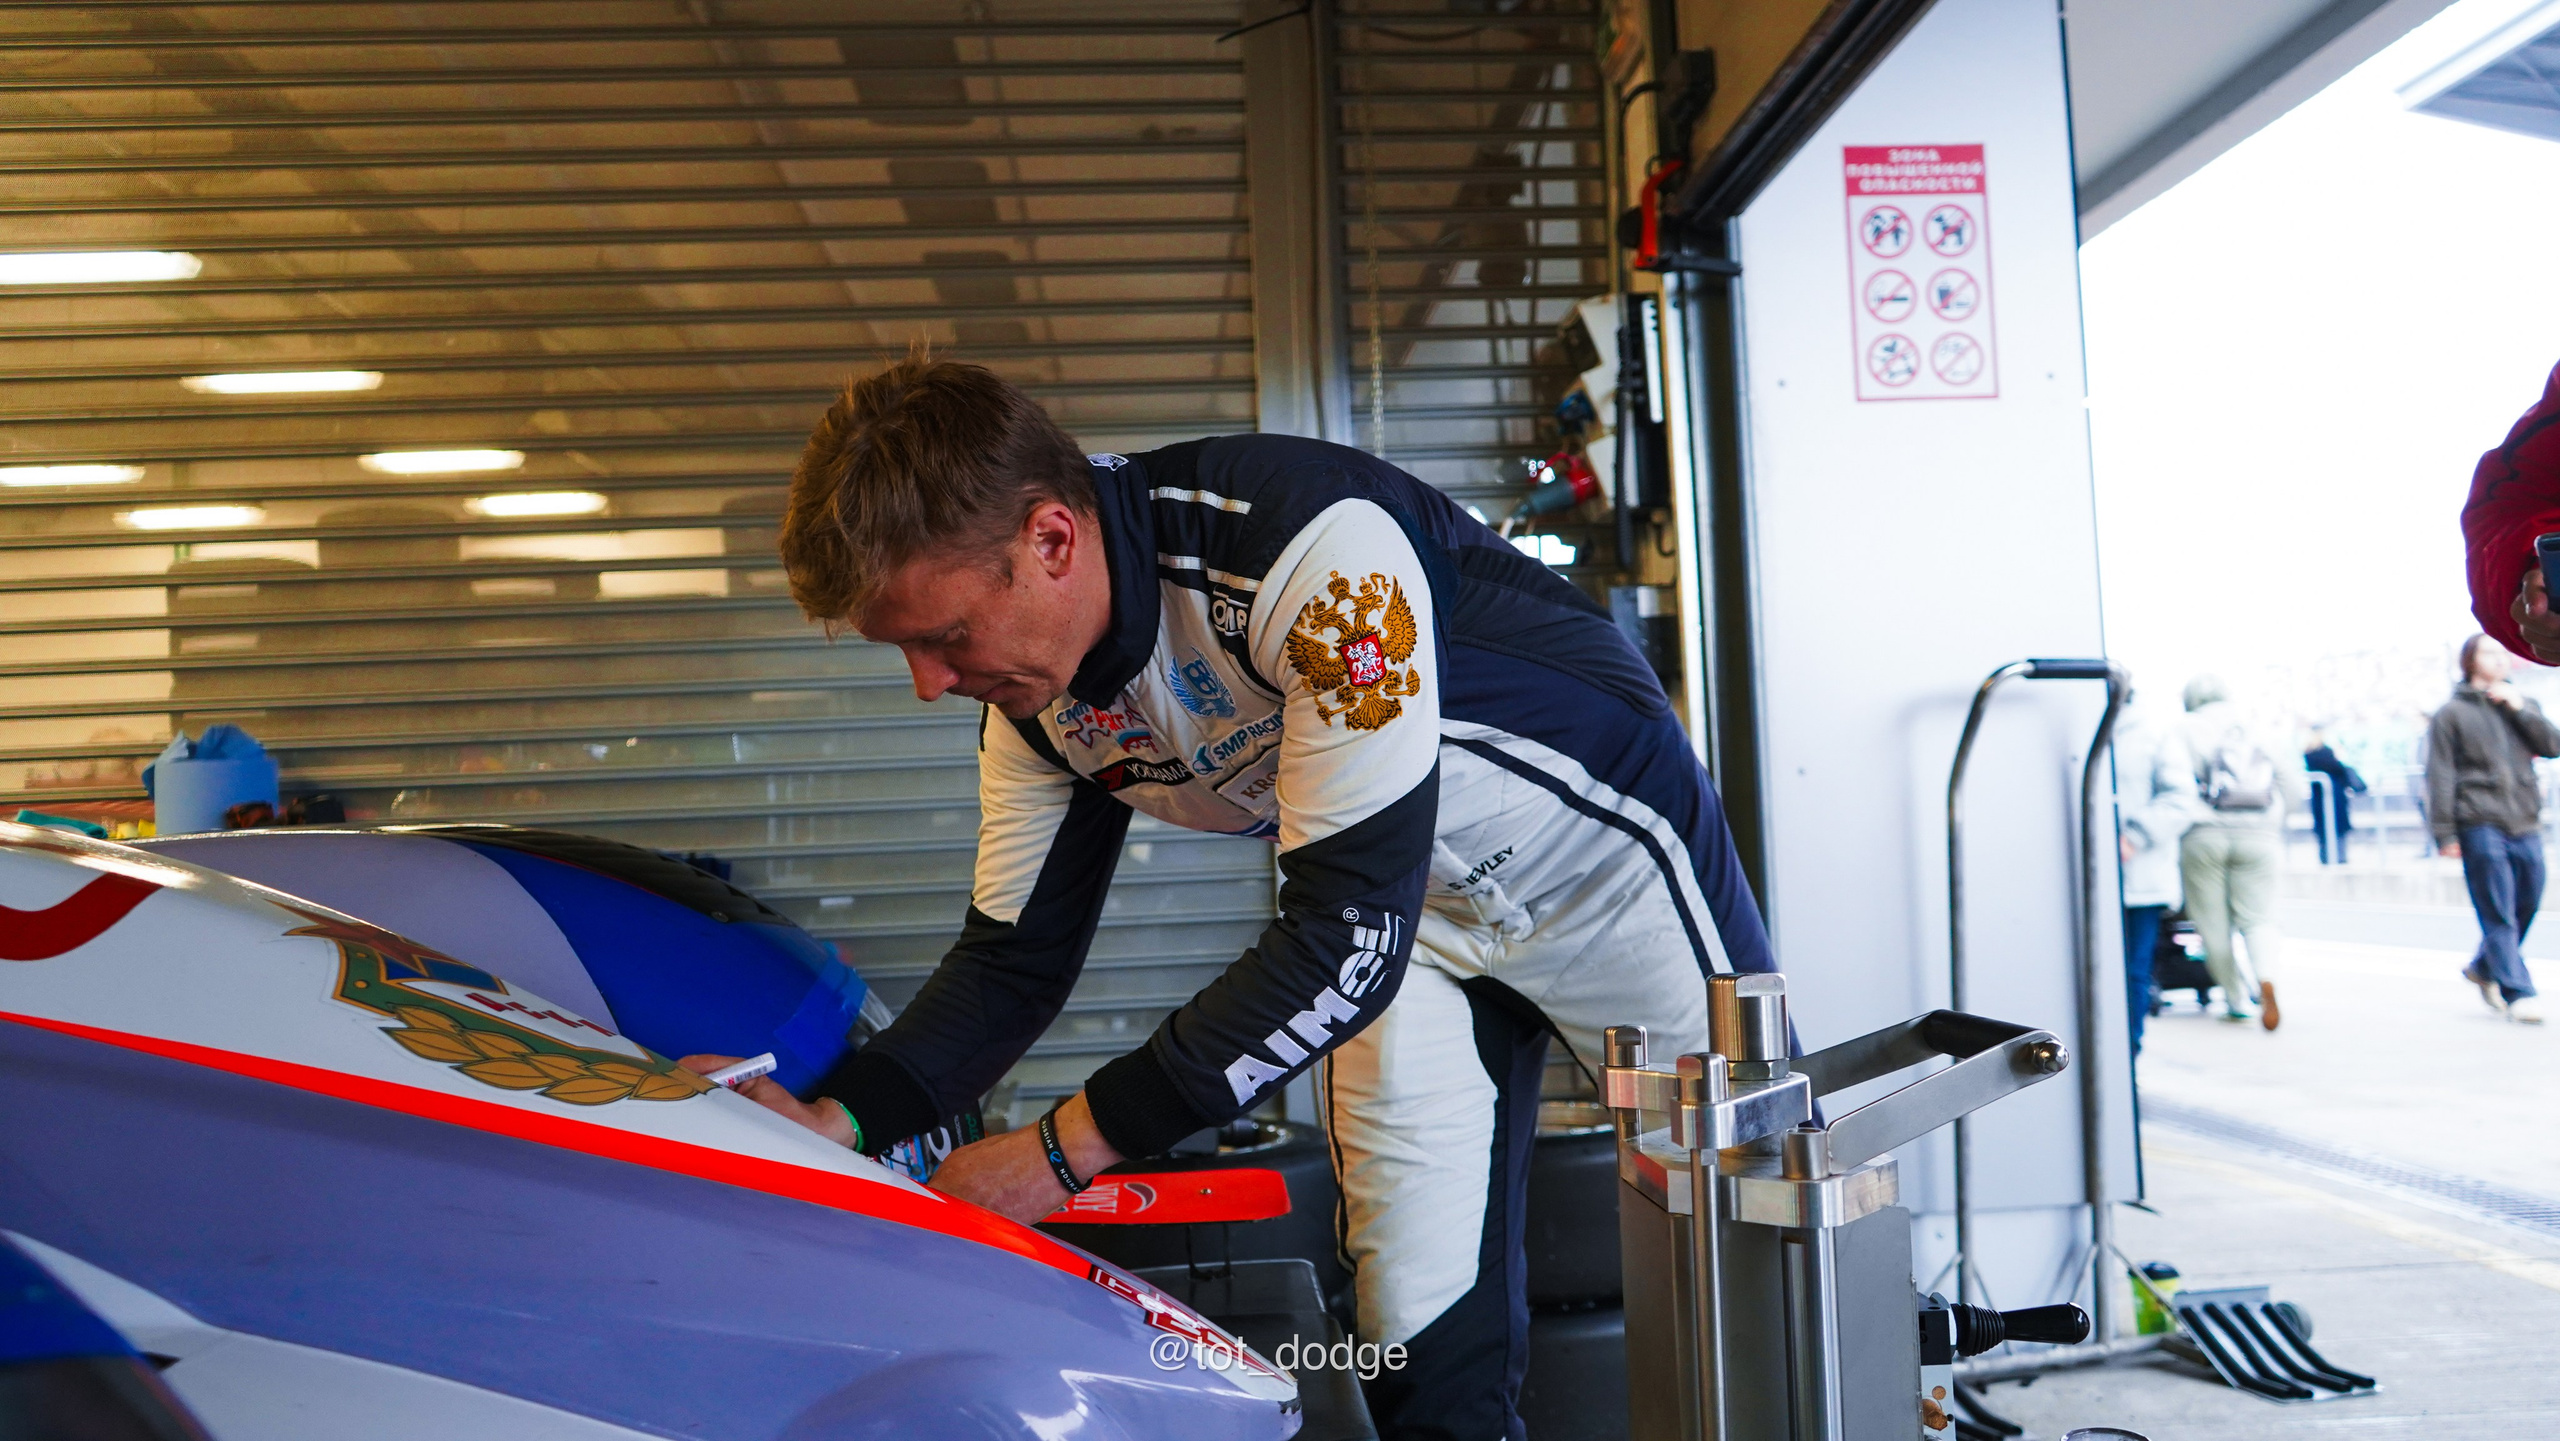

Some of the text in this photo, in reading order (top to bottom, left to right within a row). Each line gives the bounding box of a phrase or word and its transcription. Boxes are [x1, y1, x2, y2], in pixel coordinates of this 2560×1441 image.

[1213, 714, 1284, 760] SMP RACIN
[1464, 846, 1513, 885] IEVLEV
